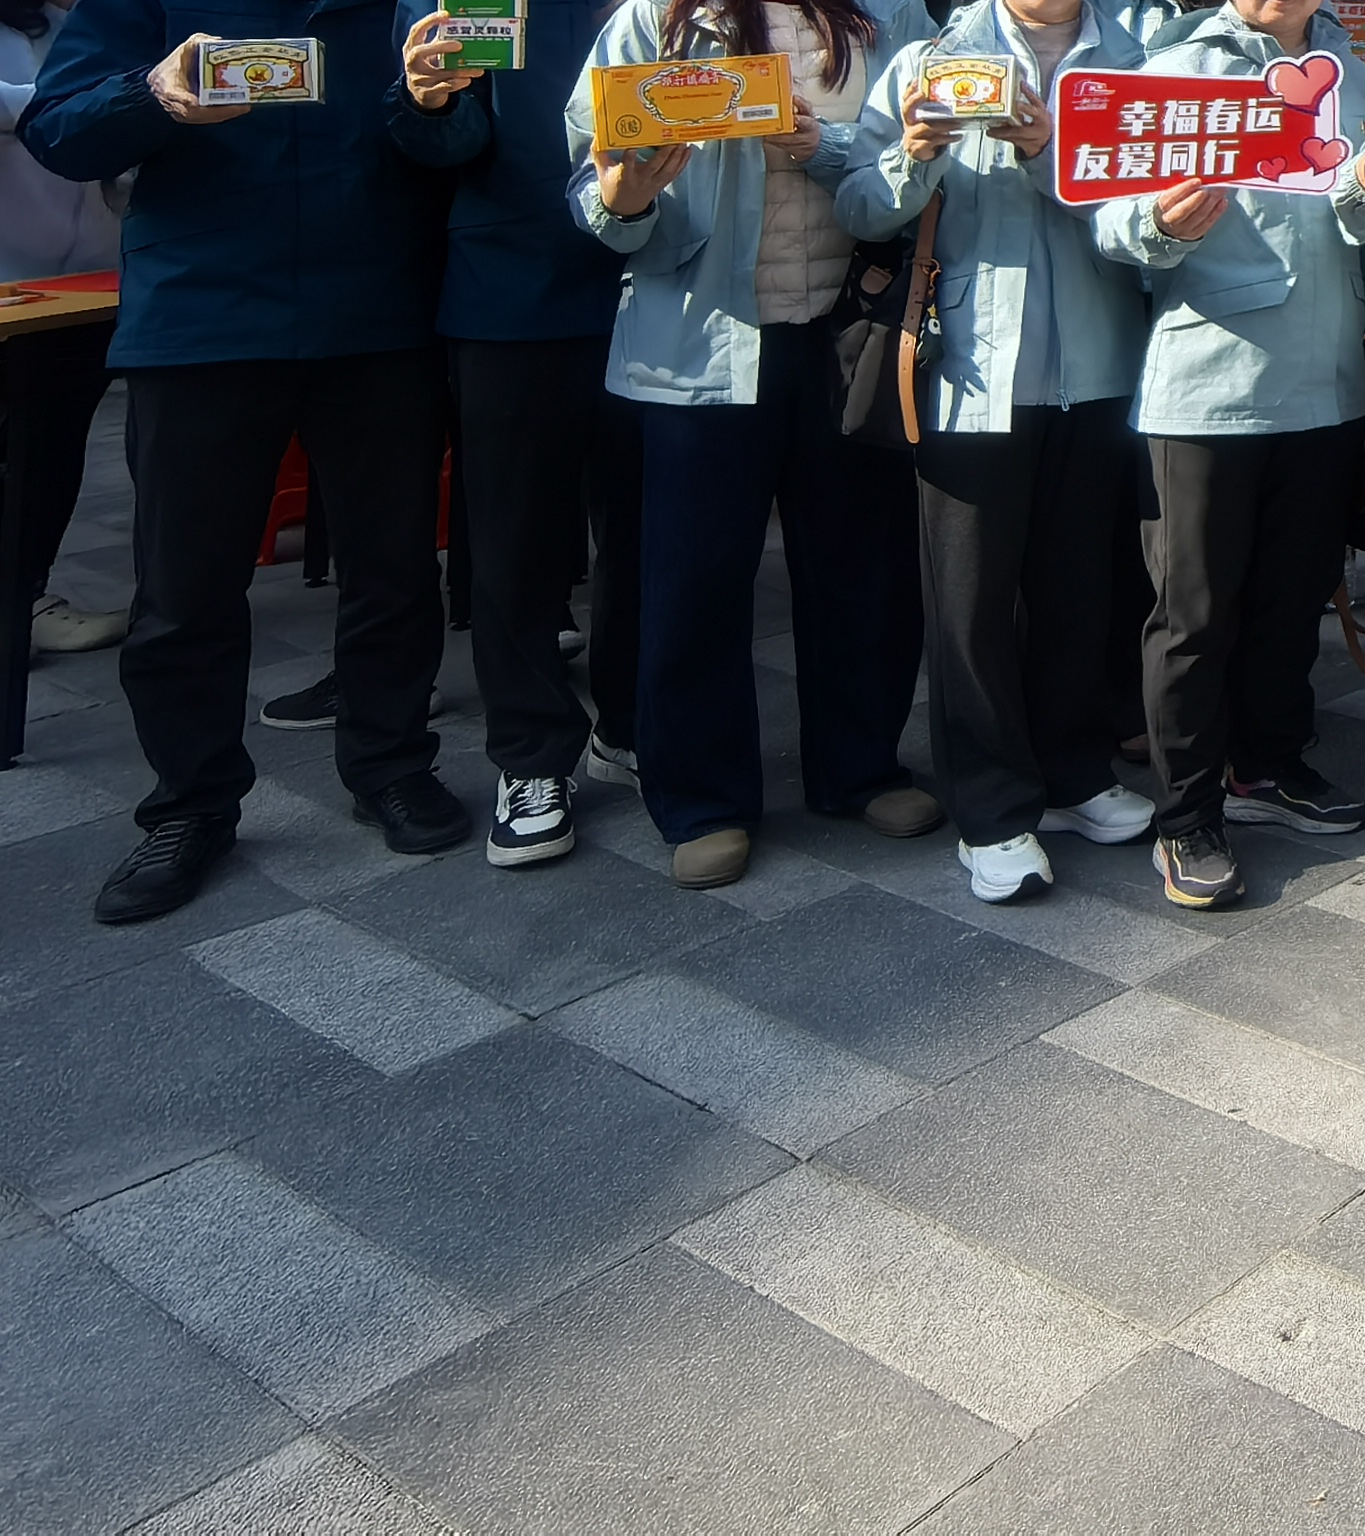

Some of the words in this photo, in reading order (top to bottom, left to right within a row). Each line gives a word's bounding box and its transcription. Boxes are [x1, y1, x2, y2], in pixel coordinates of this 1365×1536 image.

[1118, 96, 1284, 137] 幸福春运
[1072, 139, 1241, 181] 友爱同行
